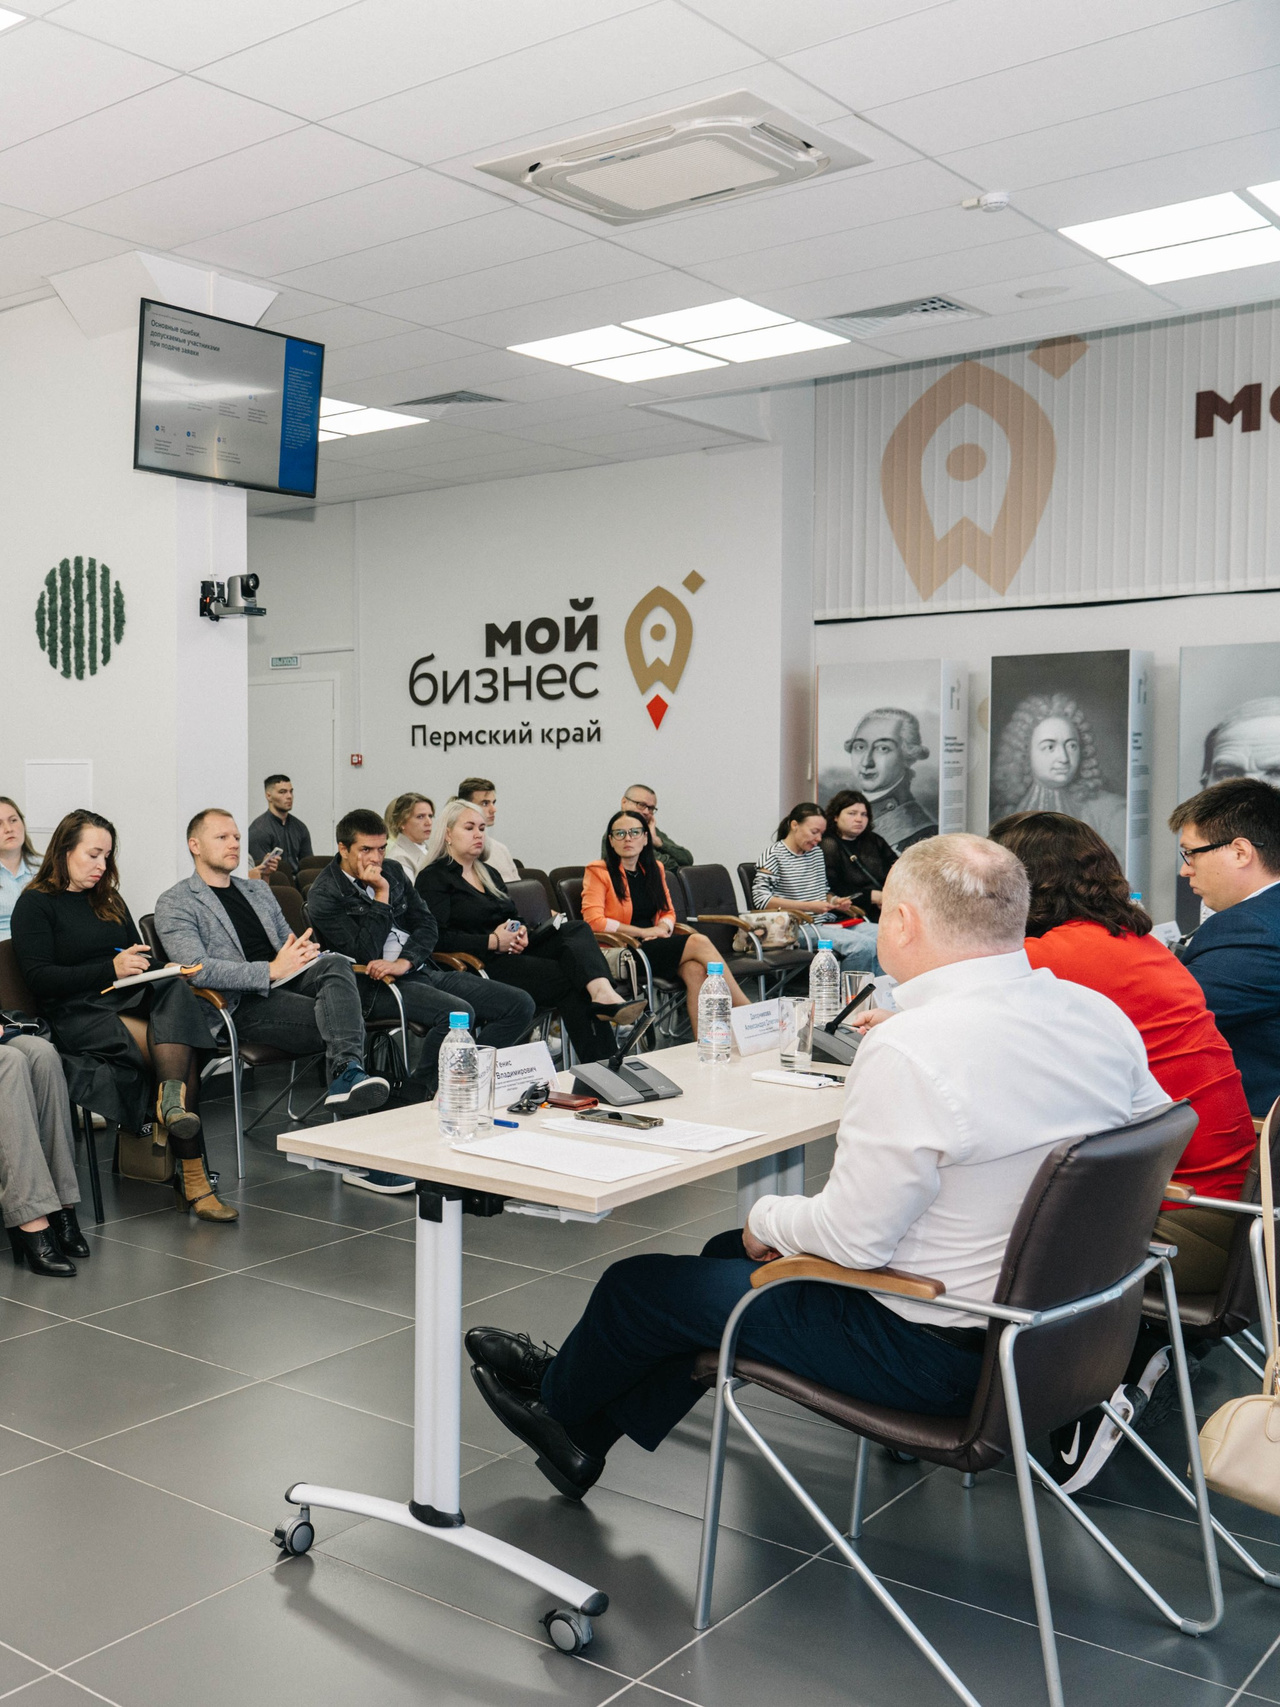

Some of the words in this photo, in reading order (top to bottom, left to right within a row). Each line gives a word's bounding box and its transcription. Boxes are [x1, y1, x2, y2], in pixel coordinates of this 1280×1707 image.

[150, 319, 178, 333] Основные
[150, 330, 186, 344] допускаемые
[187, 339, 220, 352] участниками
[150, 340, 160, 348] при
[161, 342, 180, 352] подаче
[181, 348, 200, 356] заявки
[484, 597, 599, 658] мой
[272, 657, 298, 666] ВЫХОД
[408, 652, 599, 706] бизнес
[410, 722, 533, 752] Пермский
[540, 718, 602, 750] край
[496, 1066, 537, 1080] Владимирович
